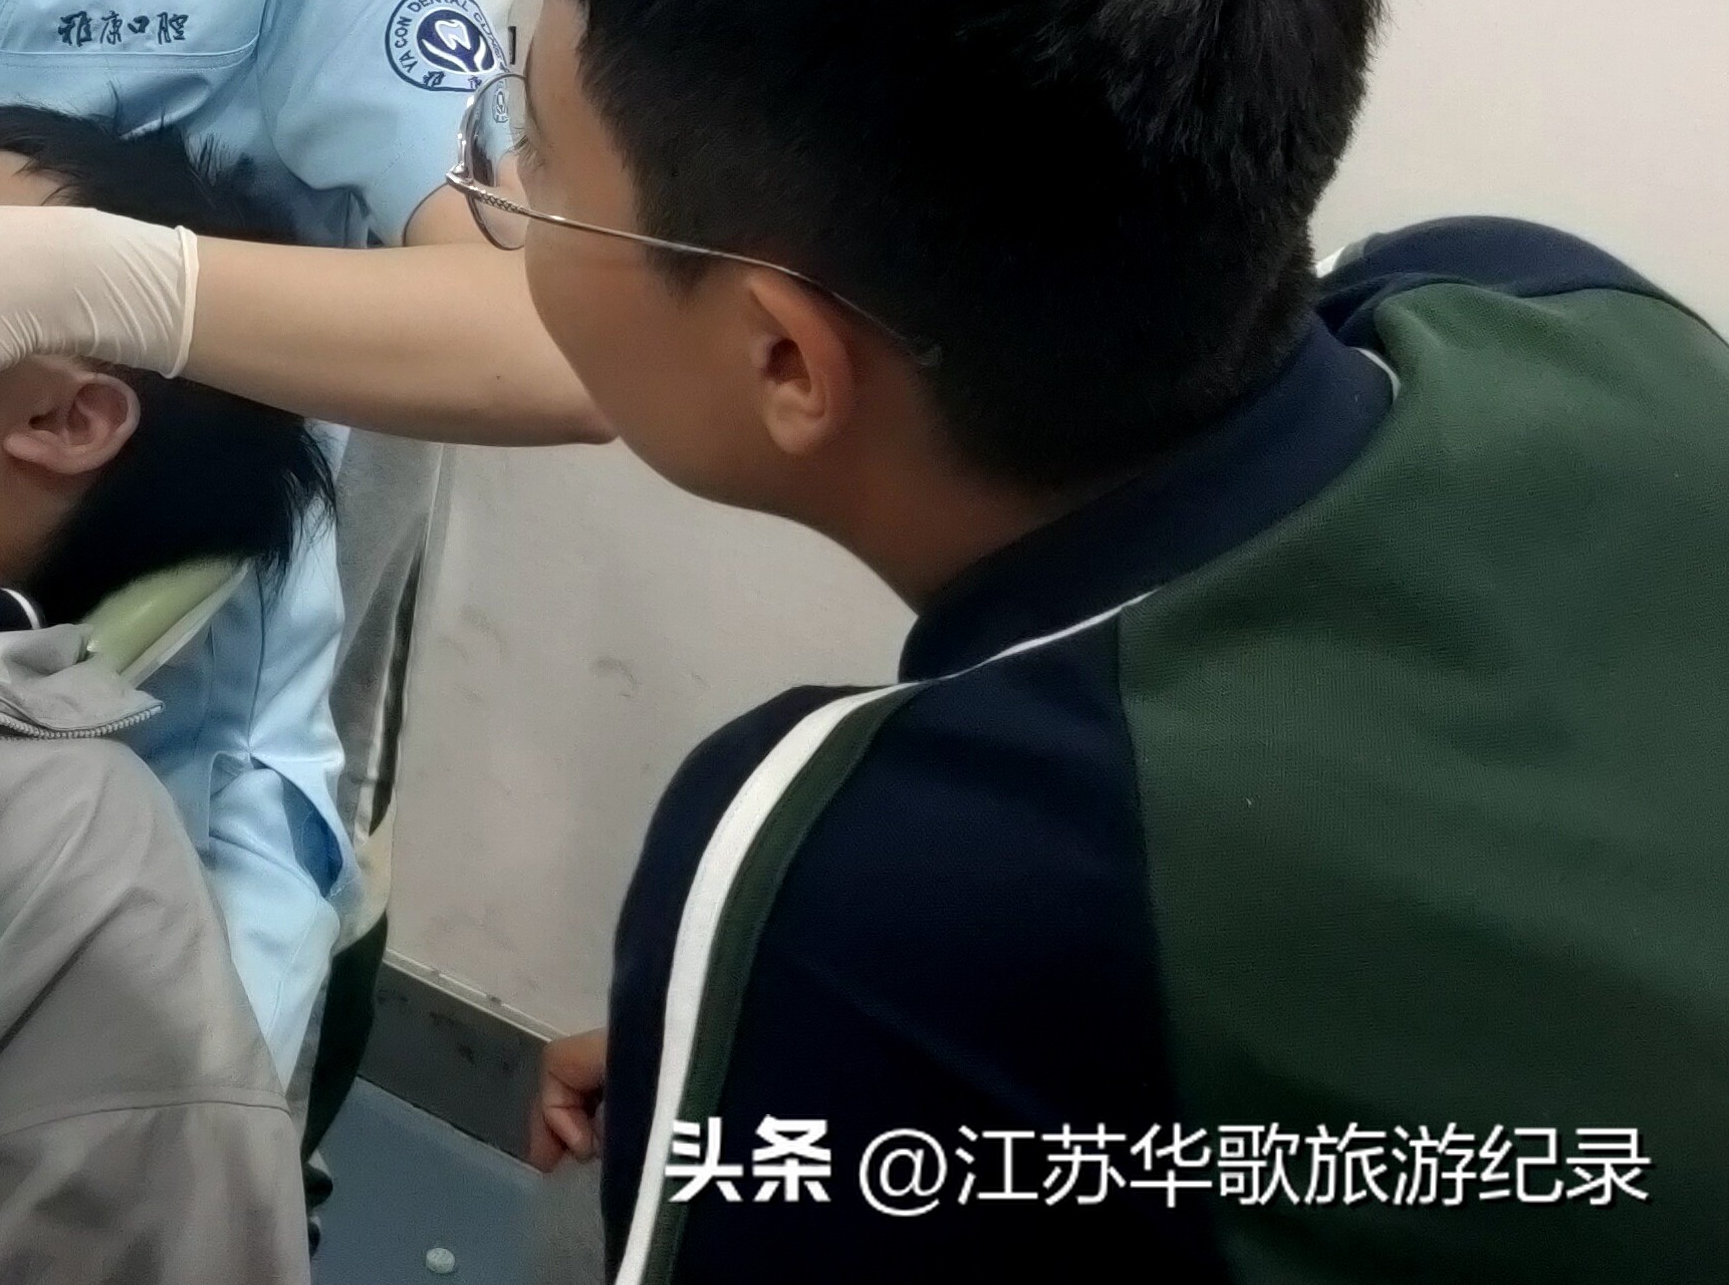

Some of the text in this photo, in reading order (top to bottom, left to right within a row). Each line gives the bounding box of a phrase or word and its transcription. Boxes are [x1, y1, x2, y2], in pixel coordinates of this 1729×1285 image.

[58, 10, 189, 47] 雅康口腔
[394, 16, 413, 49] CON
